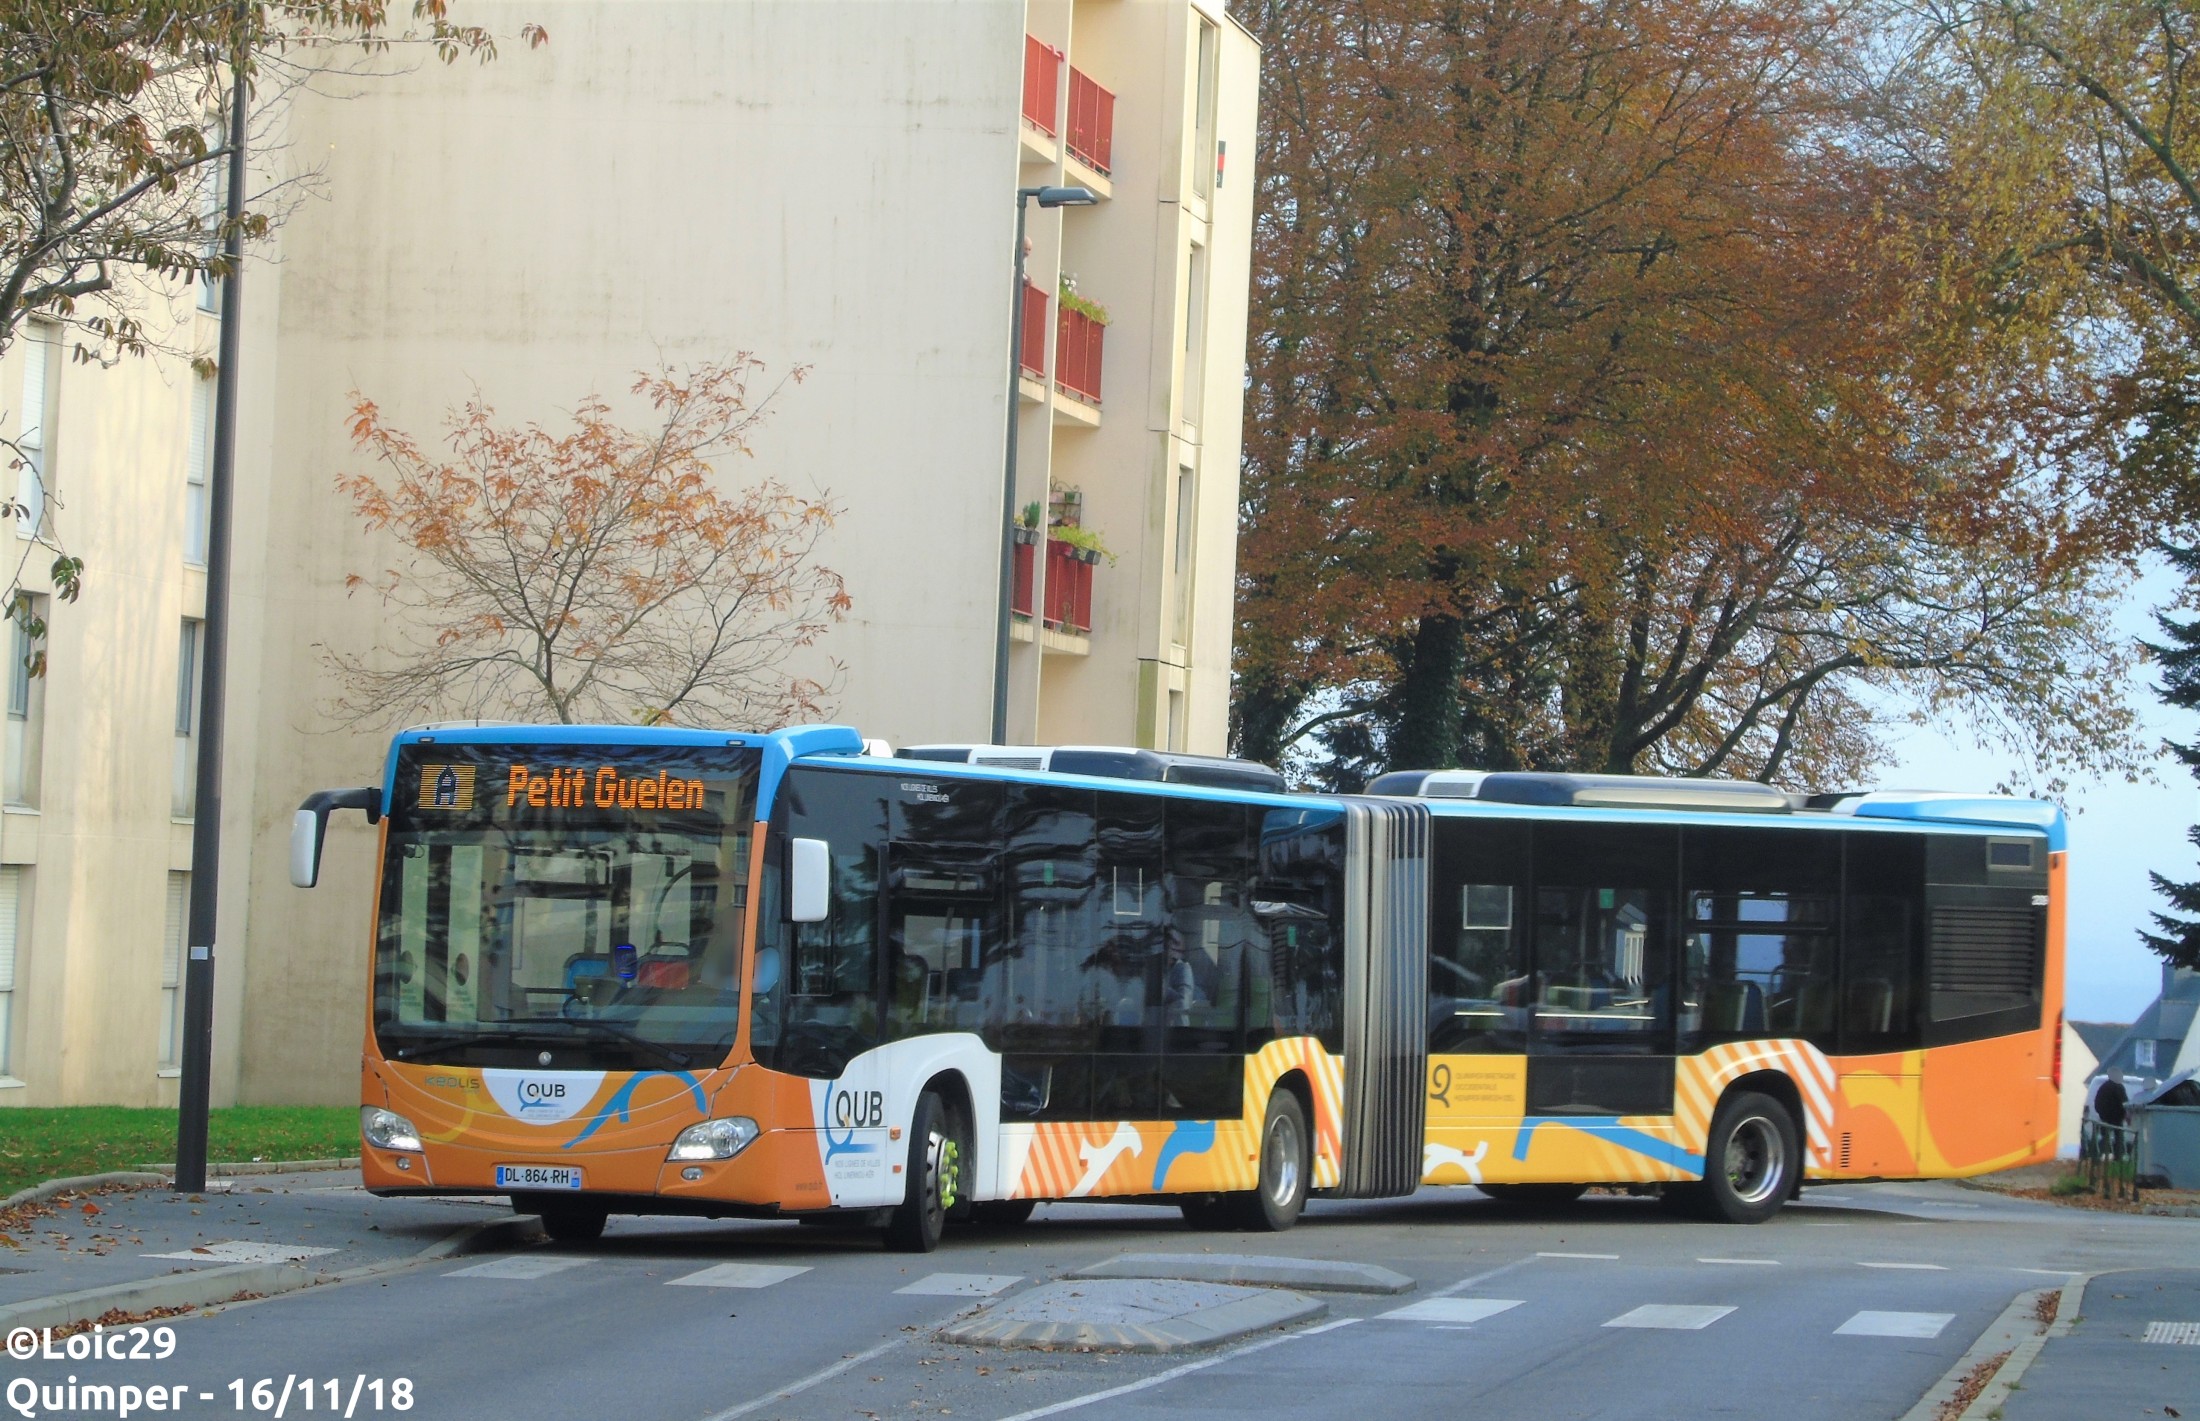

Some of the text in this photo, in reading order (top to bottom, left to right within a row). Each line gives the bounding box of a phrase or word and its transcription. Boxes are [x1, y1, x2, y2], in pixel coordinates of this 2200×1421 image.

[435, 765, 459, 806] A
[507, 764, 704, 809] Petit Guelen
[527, 1083, 566, 1098] QUB
[835, 1090, 883, 1127] QUB
